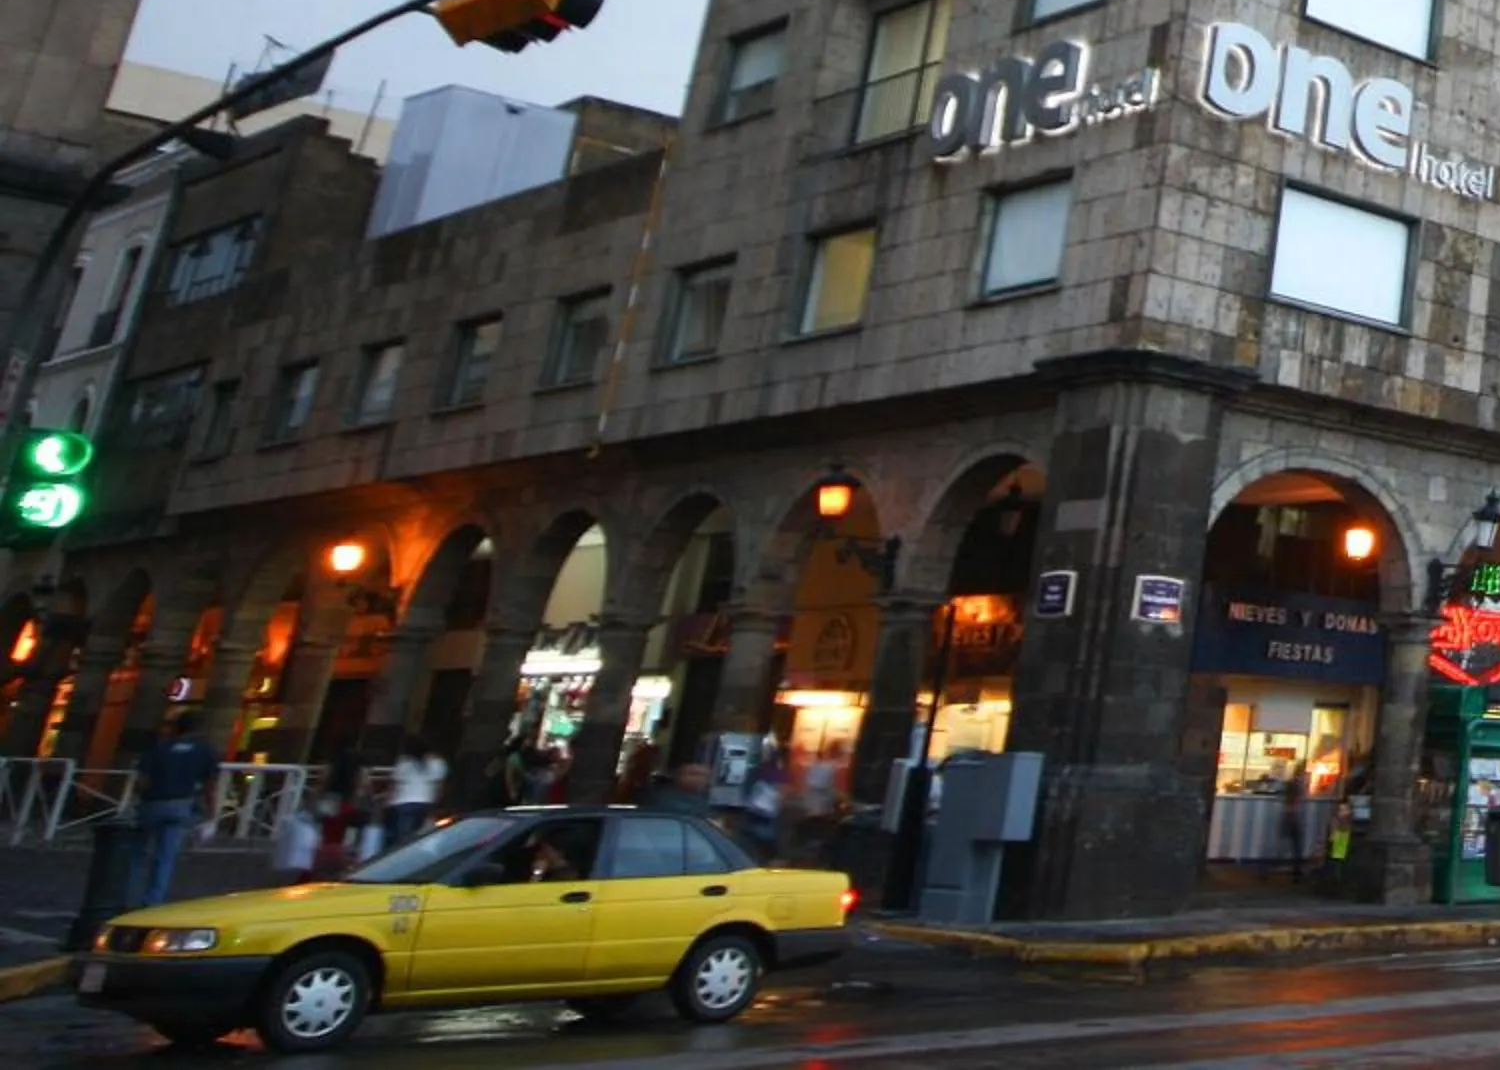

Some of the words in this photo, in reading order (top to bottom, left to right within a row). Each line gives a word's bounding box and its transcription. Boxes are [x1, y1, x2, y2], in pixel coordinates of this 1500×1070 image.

[931, 39, 1090, 162] one
[1200, 21, 1412, 174] one
[1420, 141, 1496, 201] hotel
[1228, 601, 1288, 627] NIEVES
[1301, 610, 1314, 627] Y
[1267, 640, 1336, 664] FIESTAS
